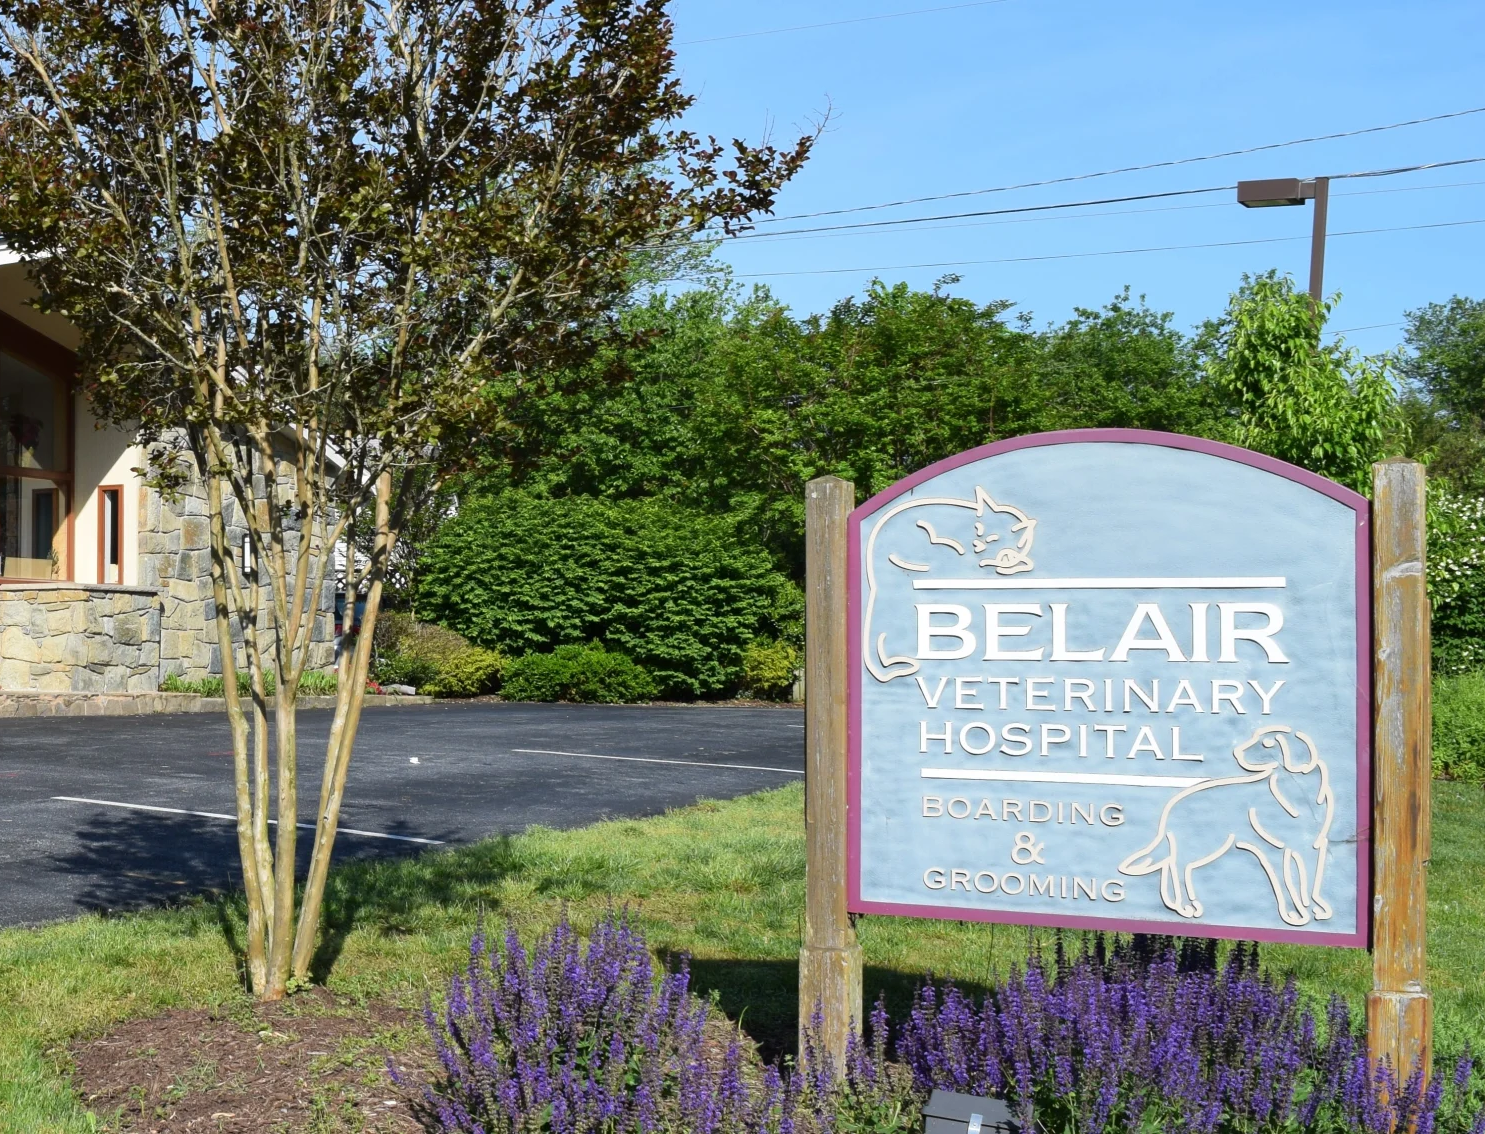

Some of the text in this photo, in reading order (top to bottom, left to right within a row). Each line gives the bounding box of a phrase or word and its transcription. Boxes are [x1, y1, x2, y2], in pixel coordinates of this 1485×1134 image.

[916, 603, 1289, 663] BELAIR
[916, 677, 1285, 714] VETERINARY
[919, 722, 1204, 761] HOSPITAL
[922, 796, 1125, 826] BOARDING
[1012, 833, 1045, 865] &
[923, 869, 1126, 902] GROOMING
